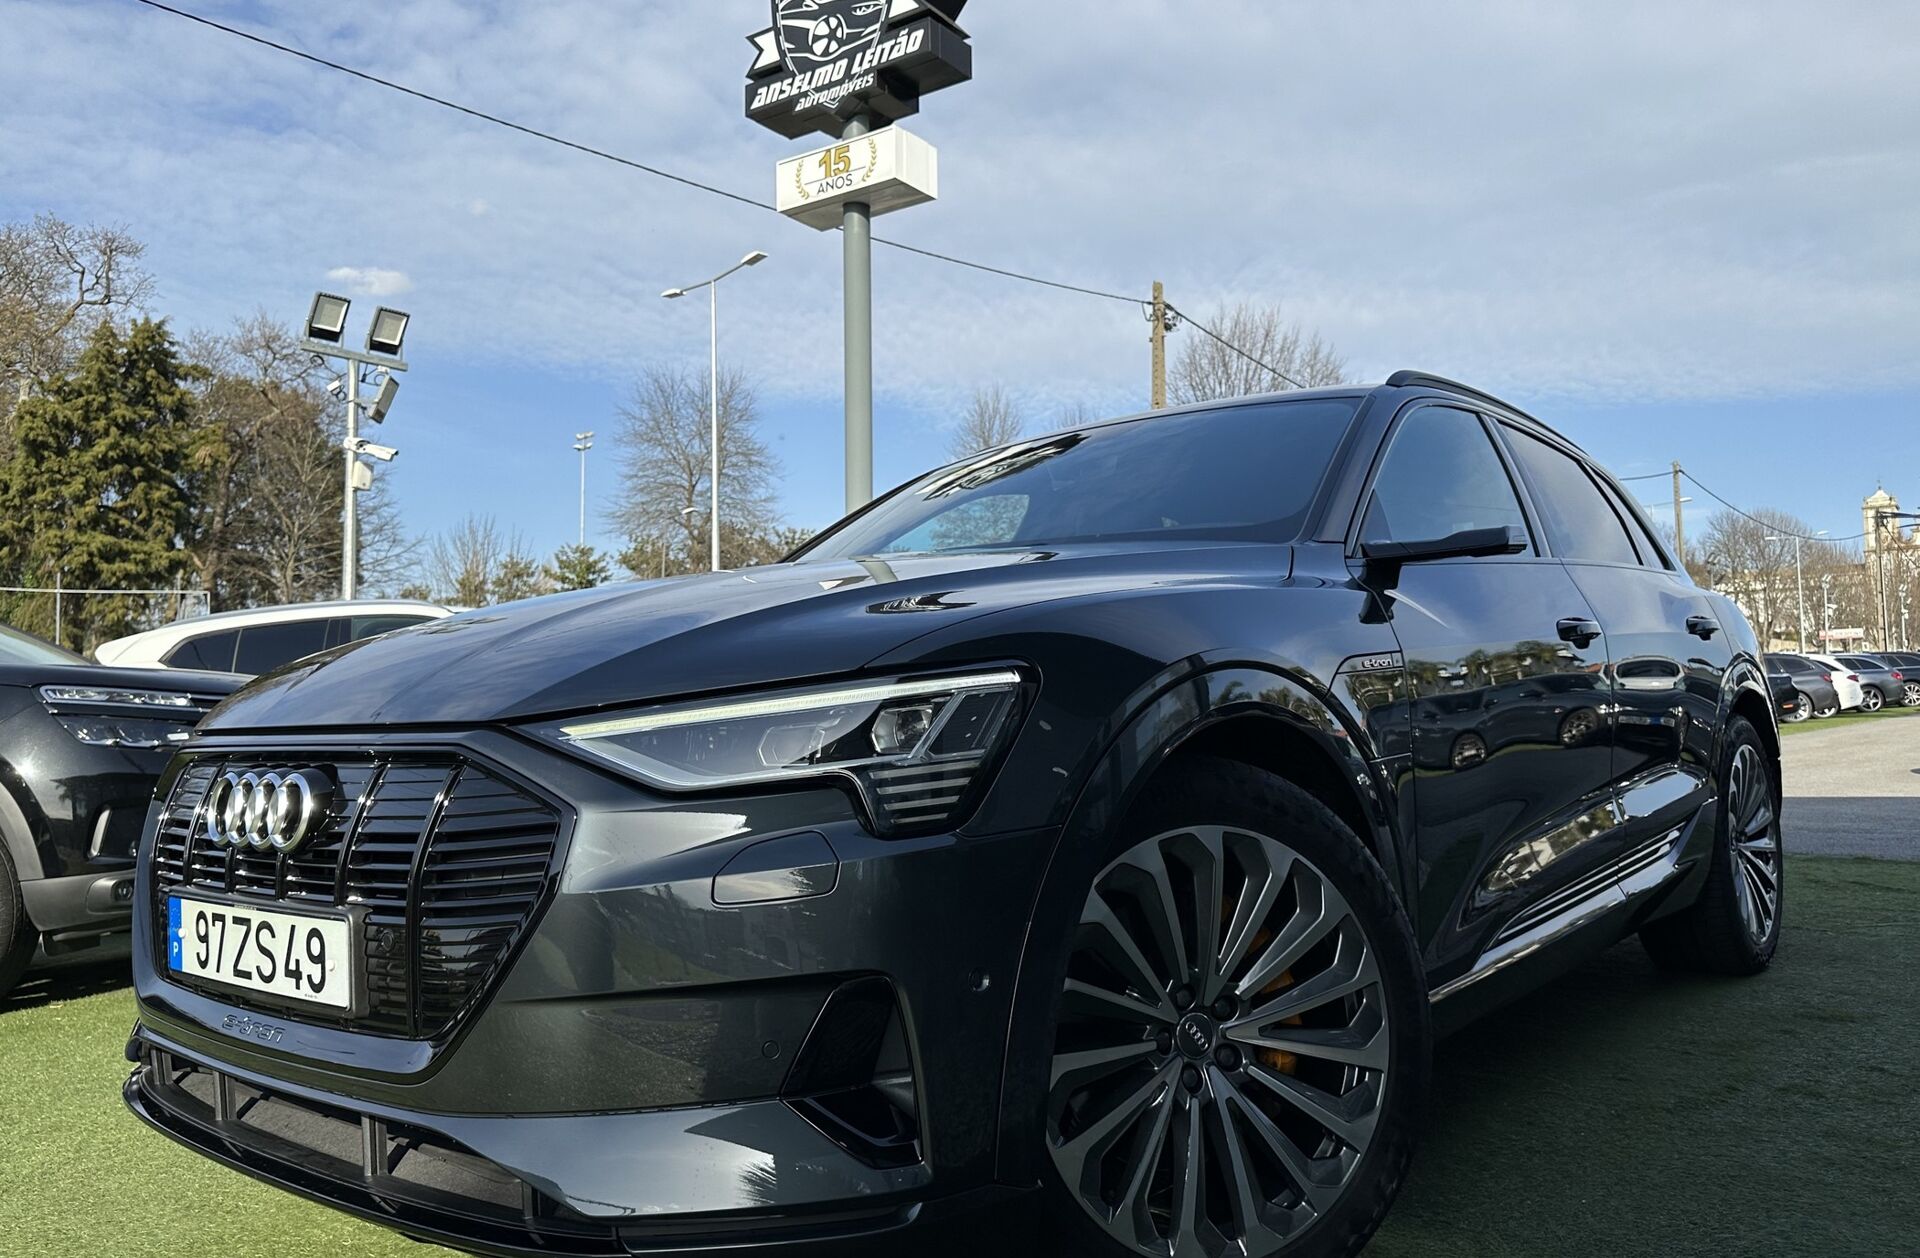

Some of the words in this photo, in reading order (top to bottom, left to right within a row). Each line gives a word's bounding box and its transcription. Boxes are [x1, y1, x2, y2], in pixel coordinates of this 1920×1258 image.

[818, 145, 851, 179] 15
[816, 173, 853, 195] ANOS
[1363, 658, 1393, 668] e-tron
[173, 941, 179, 957] P
